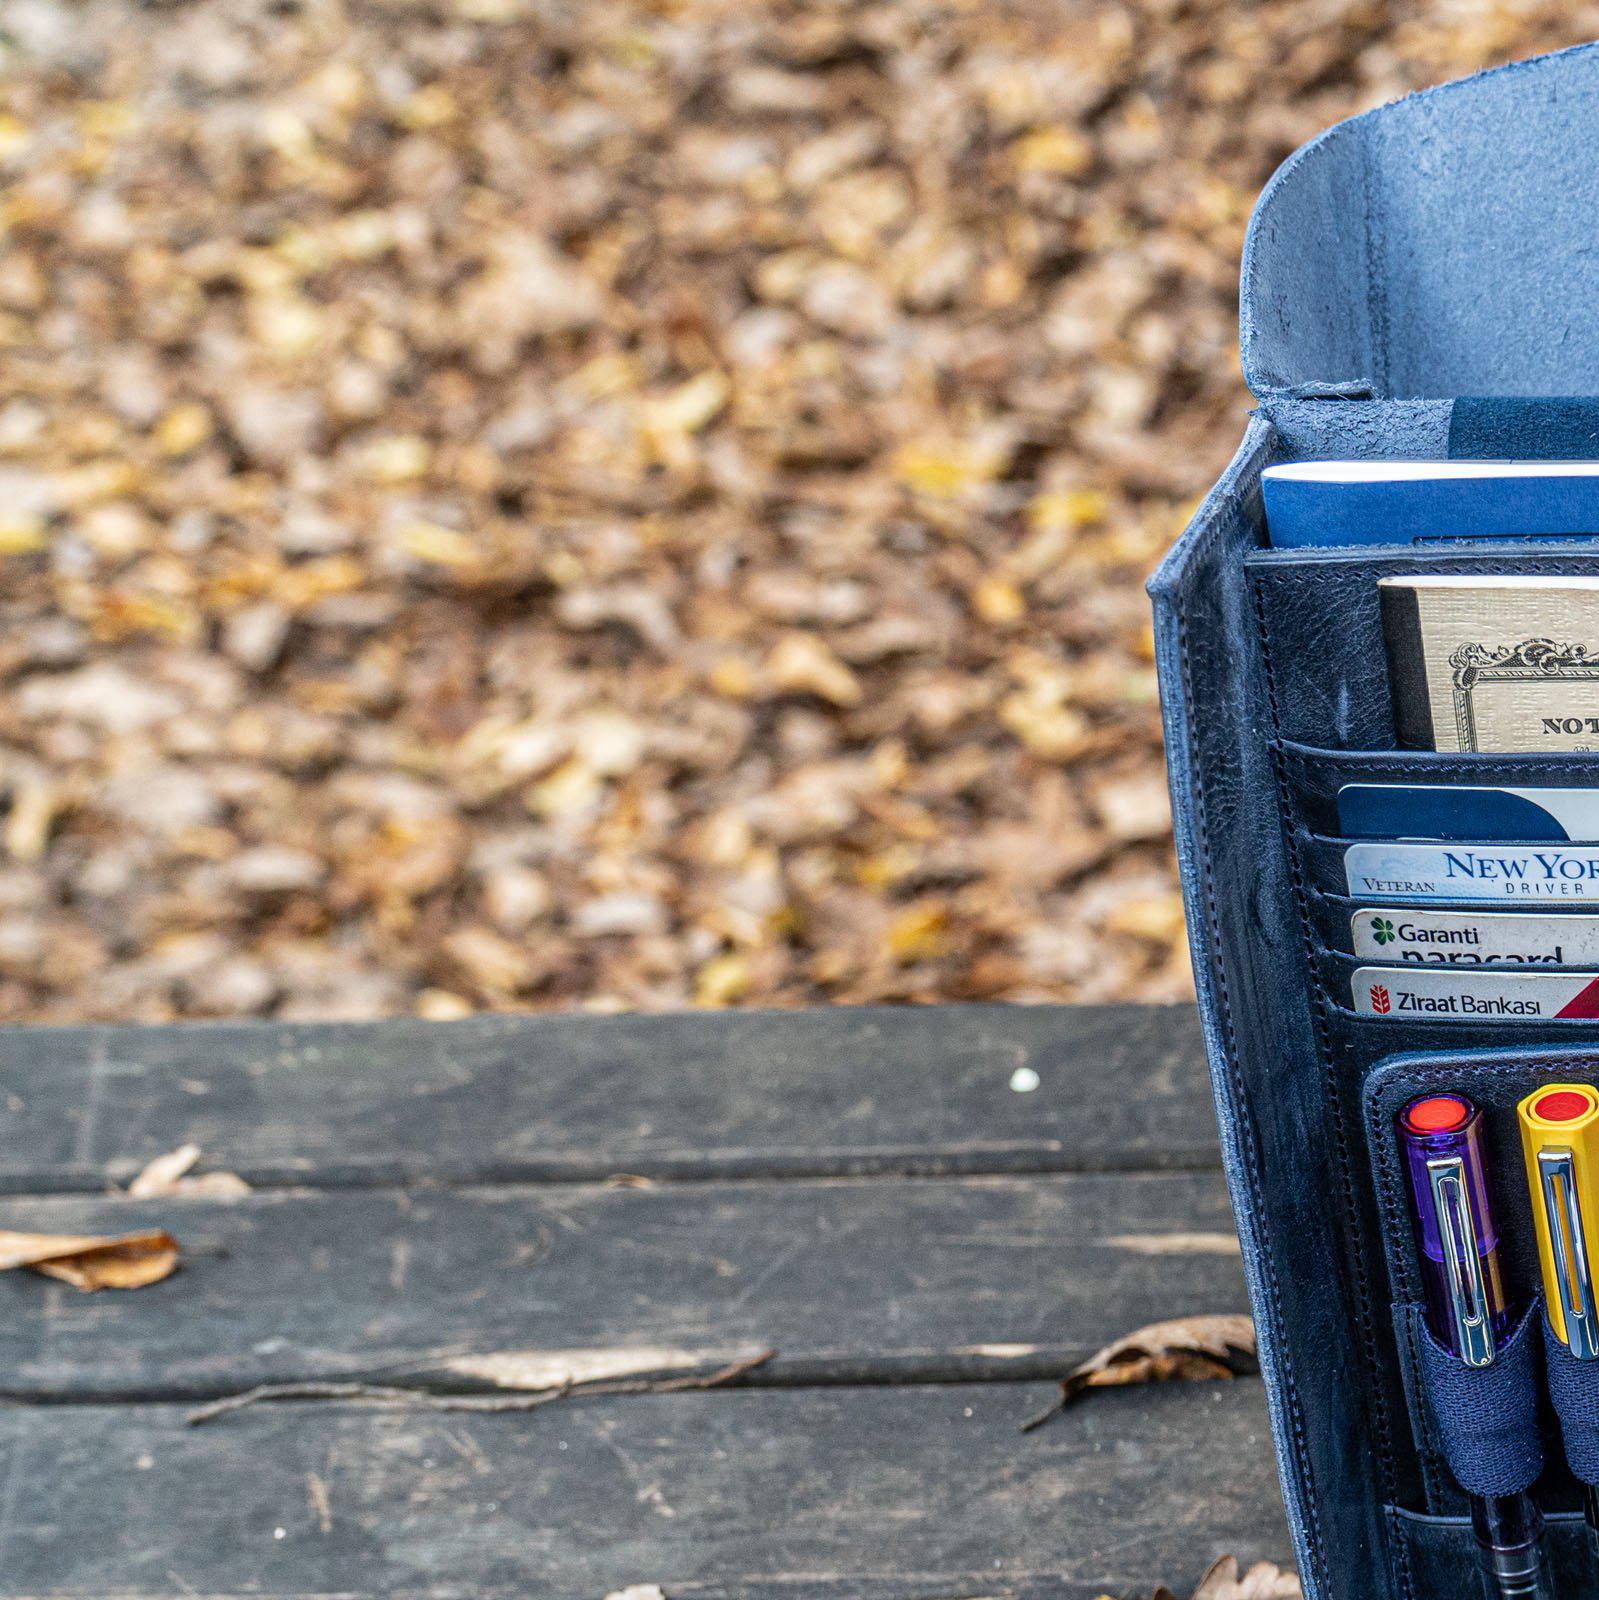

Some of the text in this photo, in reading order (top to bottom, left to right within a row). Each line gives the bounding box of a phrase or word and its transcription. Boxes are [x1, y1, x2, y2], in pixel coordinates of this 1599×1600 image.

[1443, 852, 1529, 879] NEW
[1361, 878, 1436, 893] VETERAN
[1505, 882, 1585, 895] DRIVER
[1398, 924, 1480, 945] Garanti
[1397, 992, 1459, 1013] Ziraat
